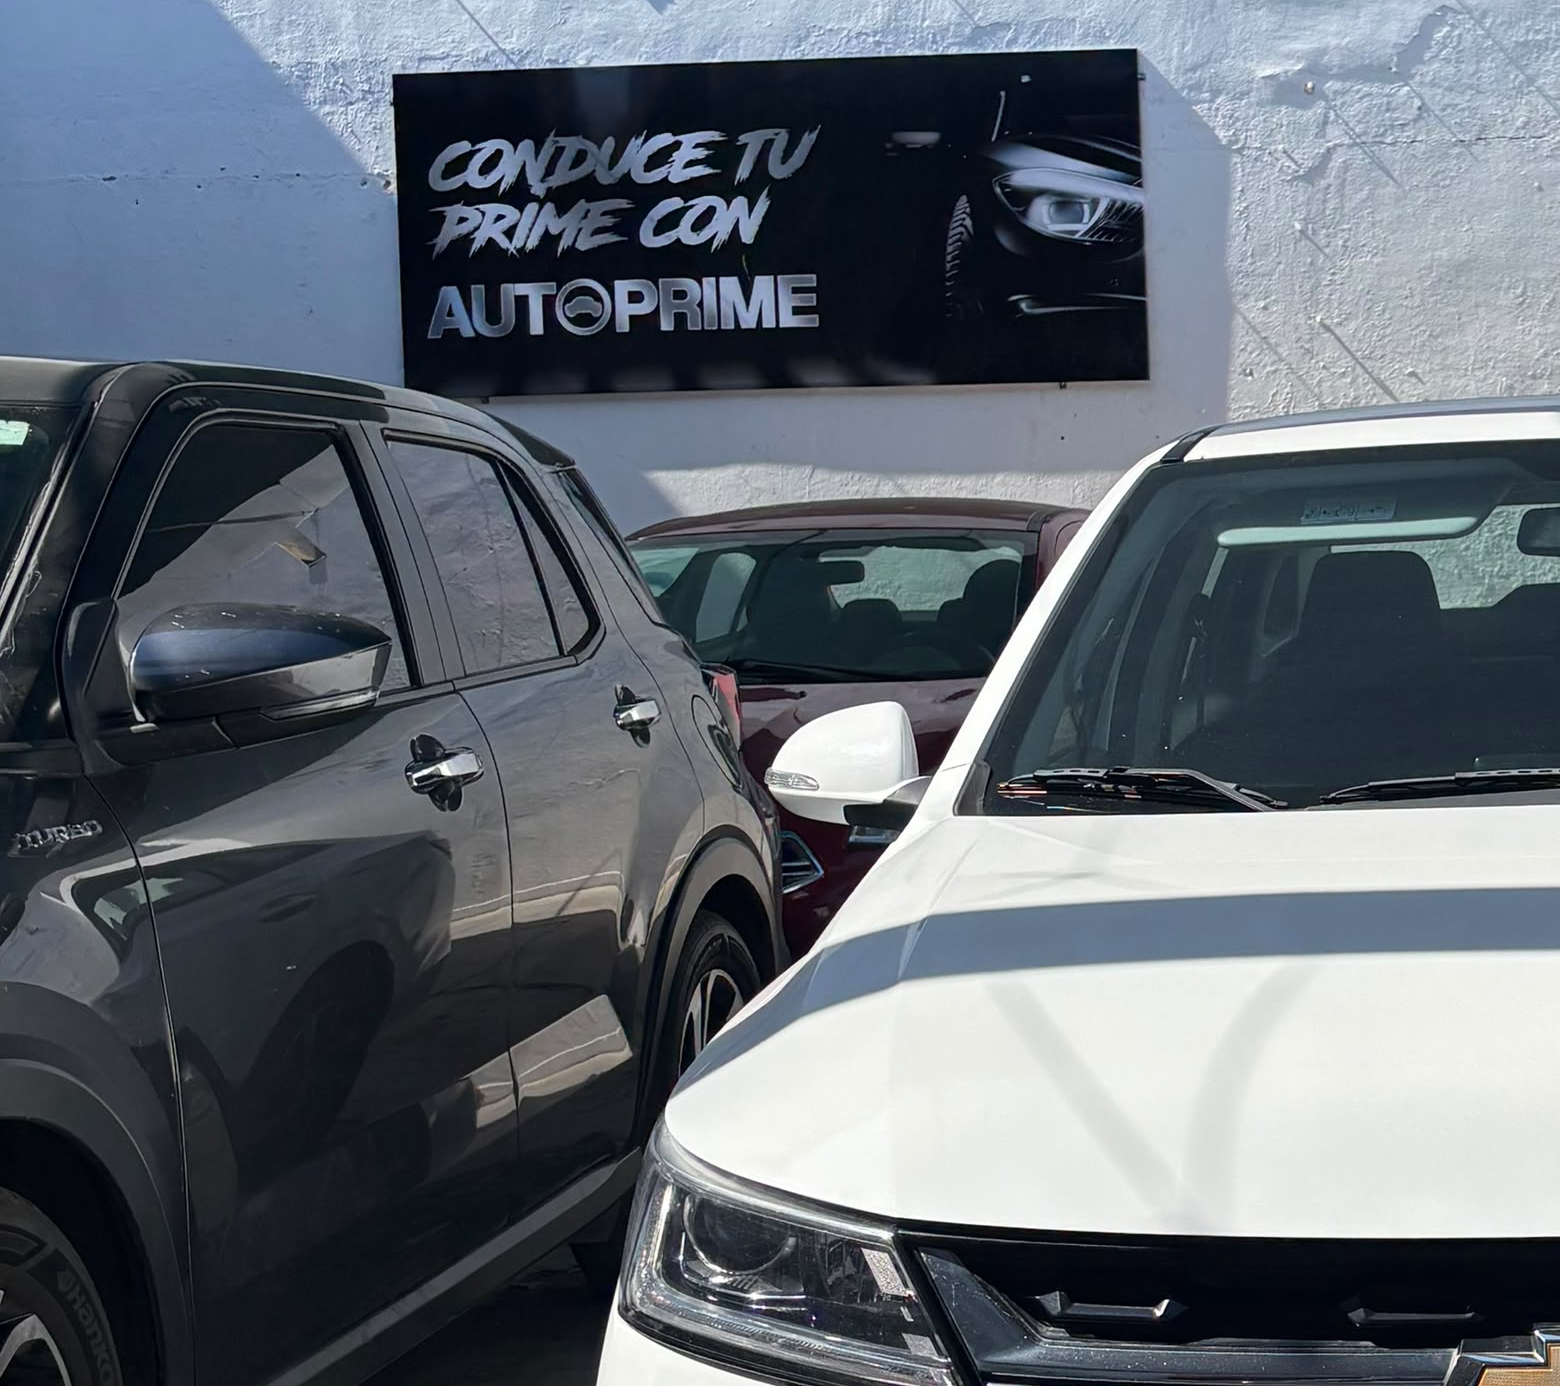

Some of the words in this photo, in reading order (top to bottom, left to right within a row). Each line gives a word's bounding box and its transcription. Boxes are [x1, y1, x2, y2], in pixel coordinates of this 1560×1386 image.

[428, 128, 728, 197] CONDUCE
[733, 125, 822, 185] TU
[426, 198, 634, 258] PRIME
[638, 186, 772, 252] CON
[427, 273, 820, 339] AUTOPRIME
